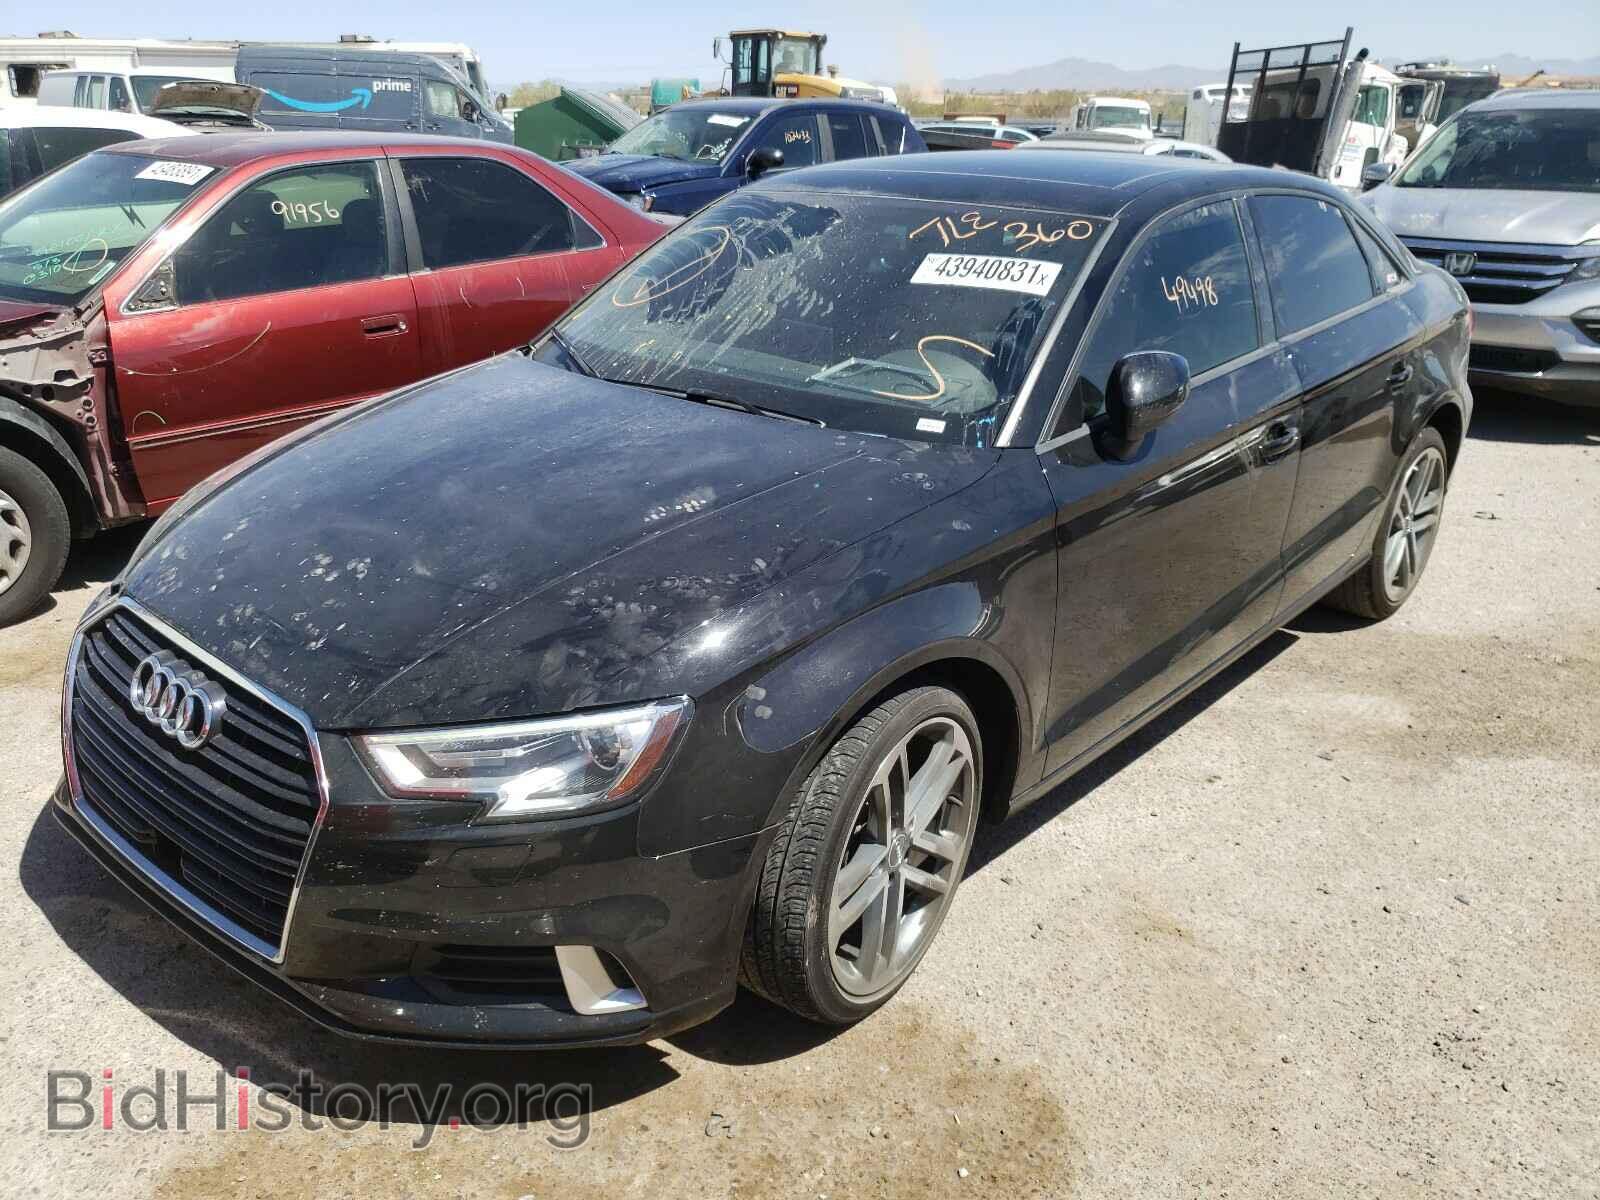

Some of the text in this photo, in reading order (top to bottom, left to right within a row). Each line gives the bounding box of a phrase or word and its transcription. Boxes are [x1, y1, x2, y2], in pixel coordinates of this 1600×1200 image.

[372, 78, 412, 93] prime
[271, 200, 340, 224] 91956
[1003, 220, 1093, 252] 360
[935, 256, 1041, 284] 43940831
[1160, 275, 1219, 314] 49498
